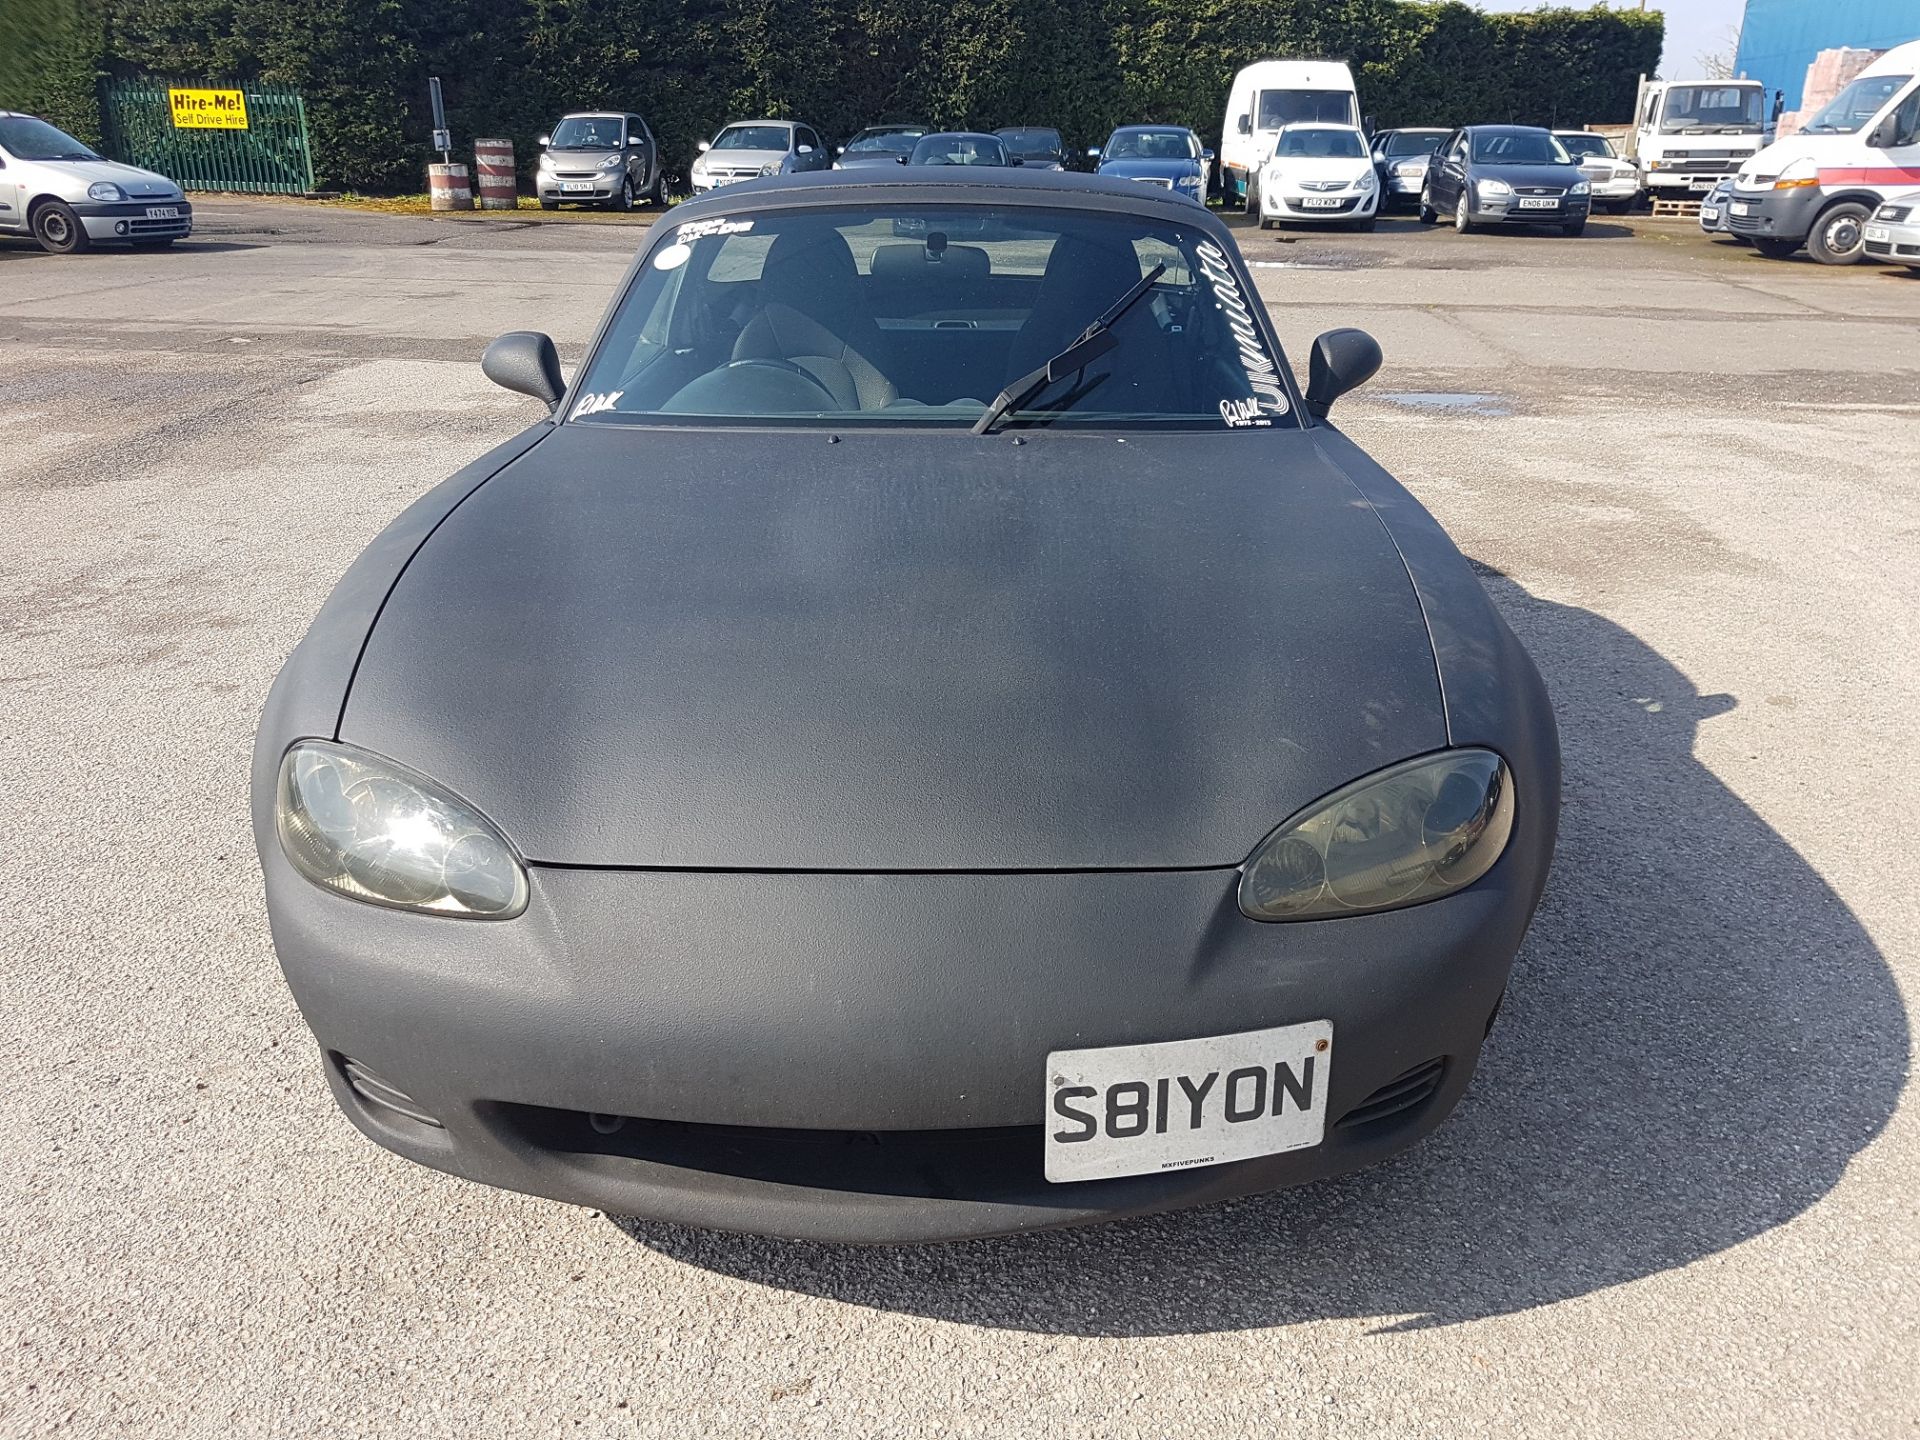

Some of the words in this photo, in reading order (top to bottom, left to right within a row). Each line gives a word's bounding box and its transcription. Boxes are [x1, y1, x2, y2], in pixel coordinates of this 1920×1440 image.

[174, 93, 241, 110] Hire-Me!
[176, 113, 194, 124] Self
[197, 114, 222, 124] Drive
[225, 114, 245, 125] Hire
[1523, 199, 1541, 208] EN06
[1161, 1156, 1215, 1169] MXFIVEPUNKS
